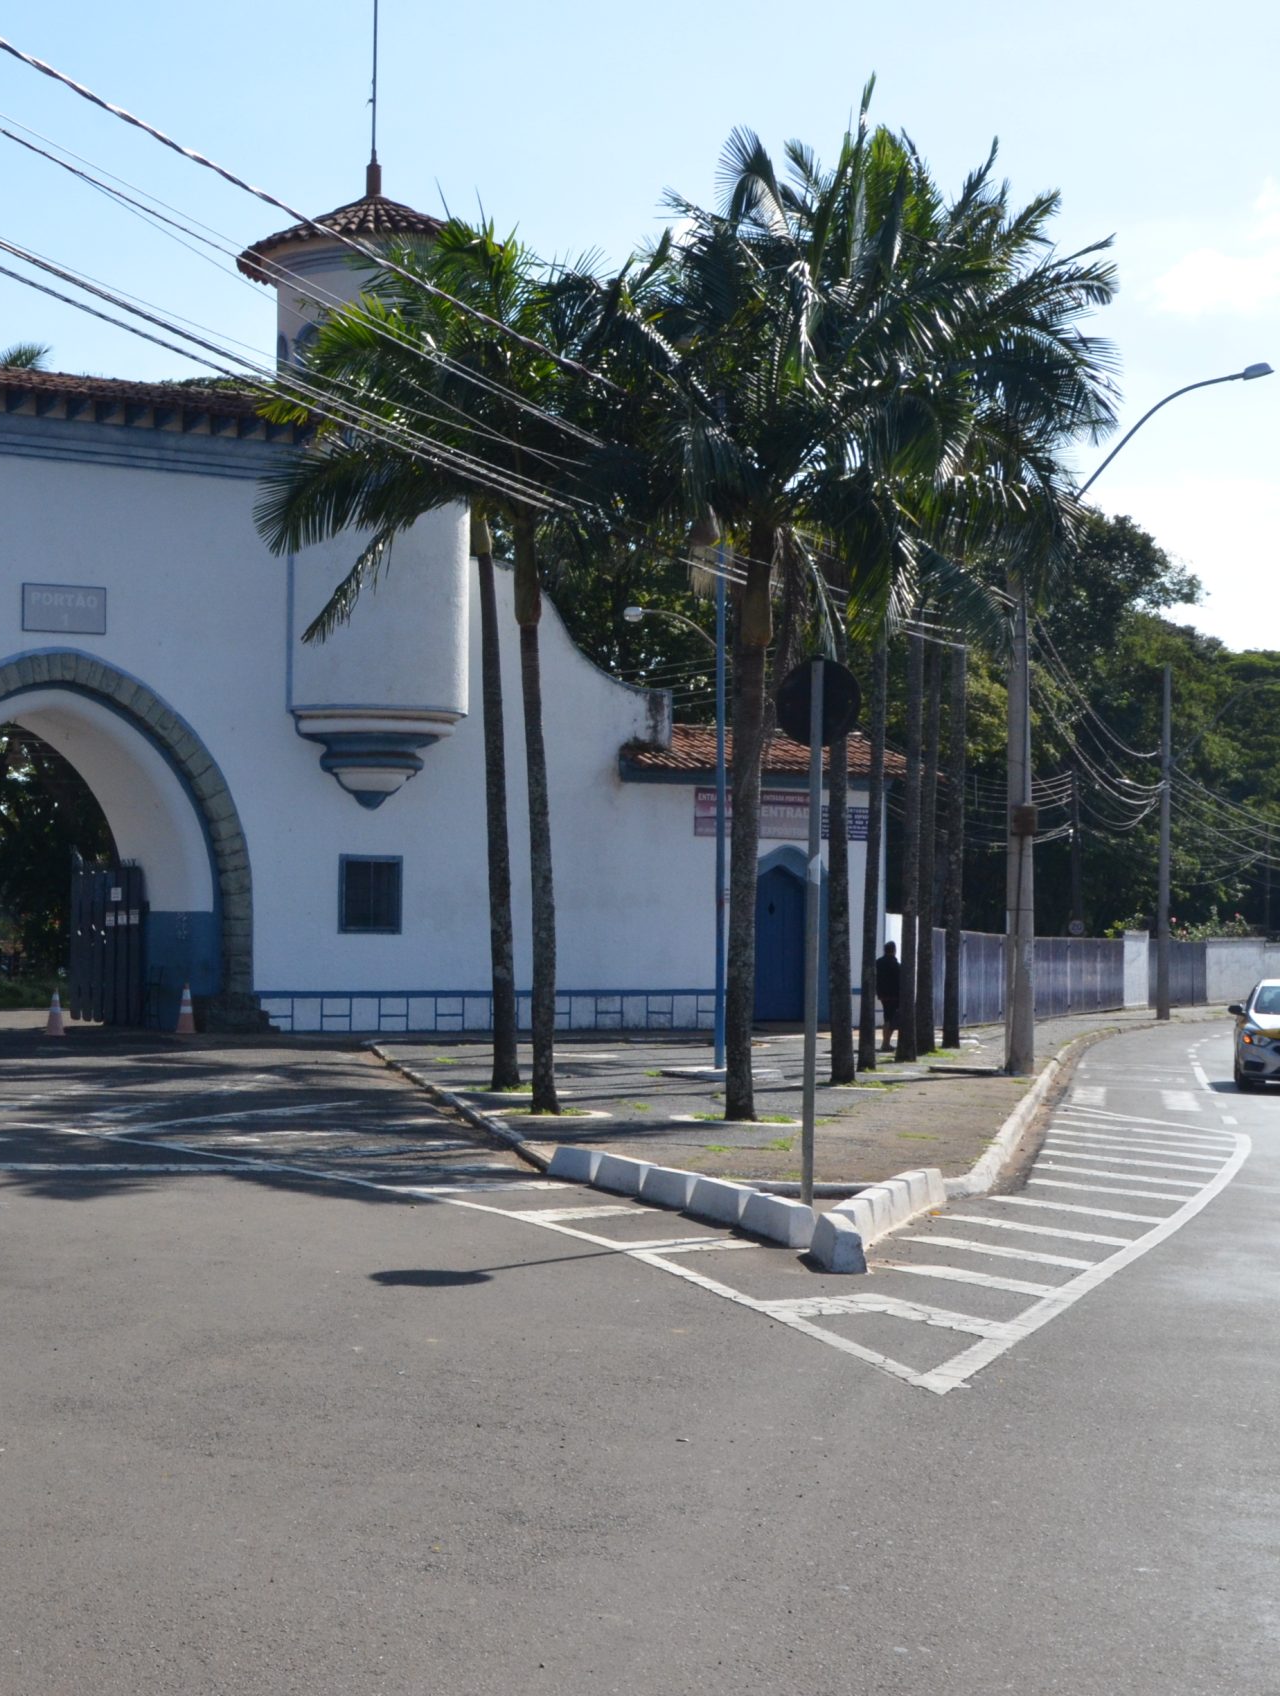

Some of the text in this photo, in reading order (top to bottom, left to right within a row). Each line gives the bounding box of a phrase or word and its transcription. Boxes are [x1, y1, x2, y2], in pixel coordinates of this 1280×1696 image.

[31, 590, 98, 608] PORTÃO
[61, 613, 69, 626] 1
[761, 805, 810, 819] ENTRAD
